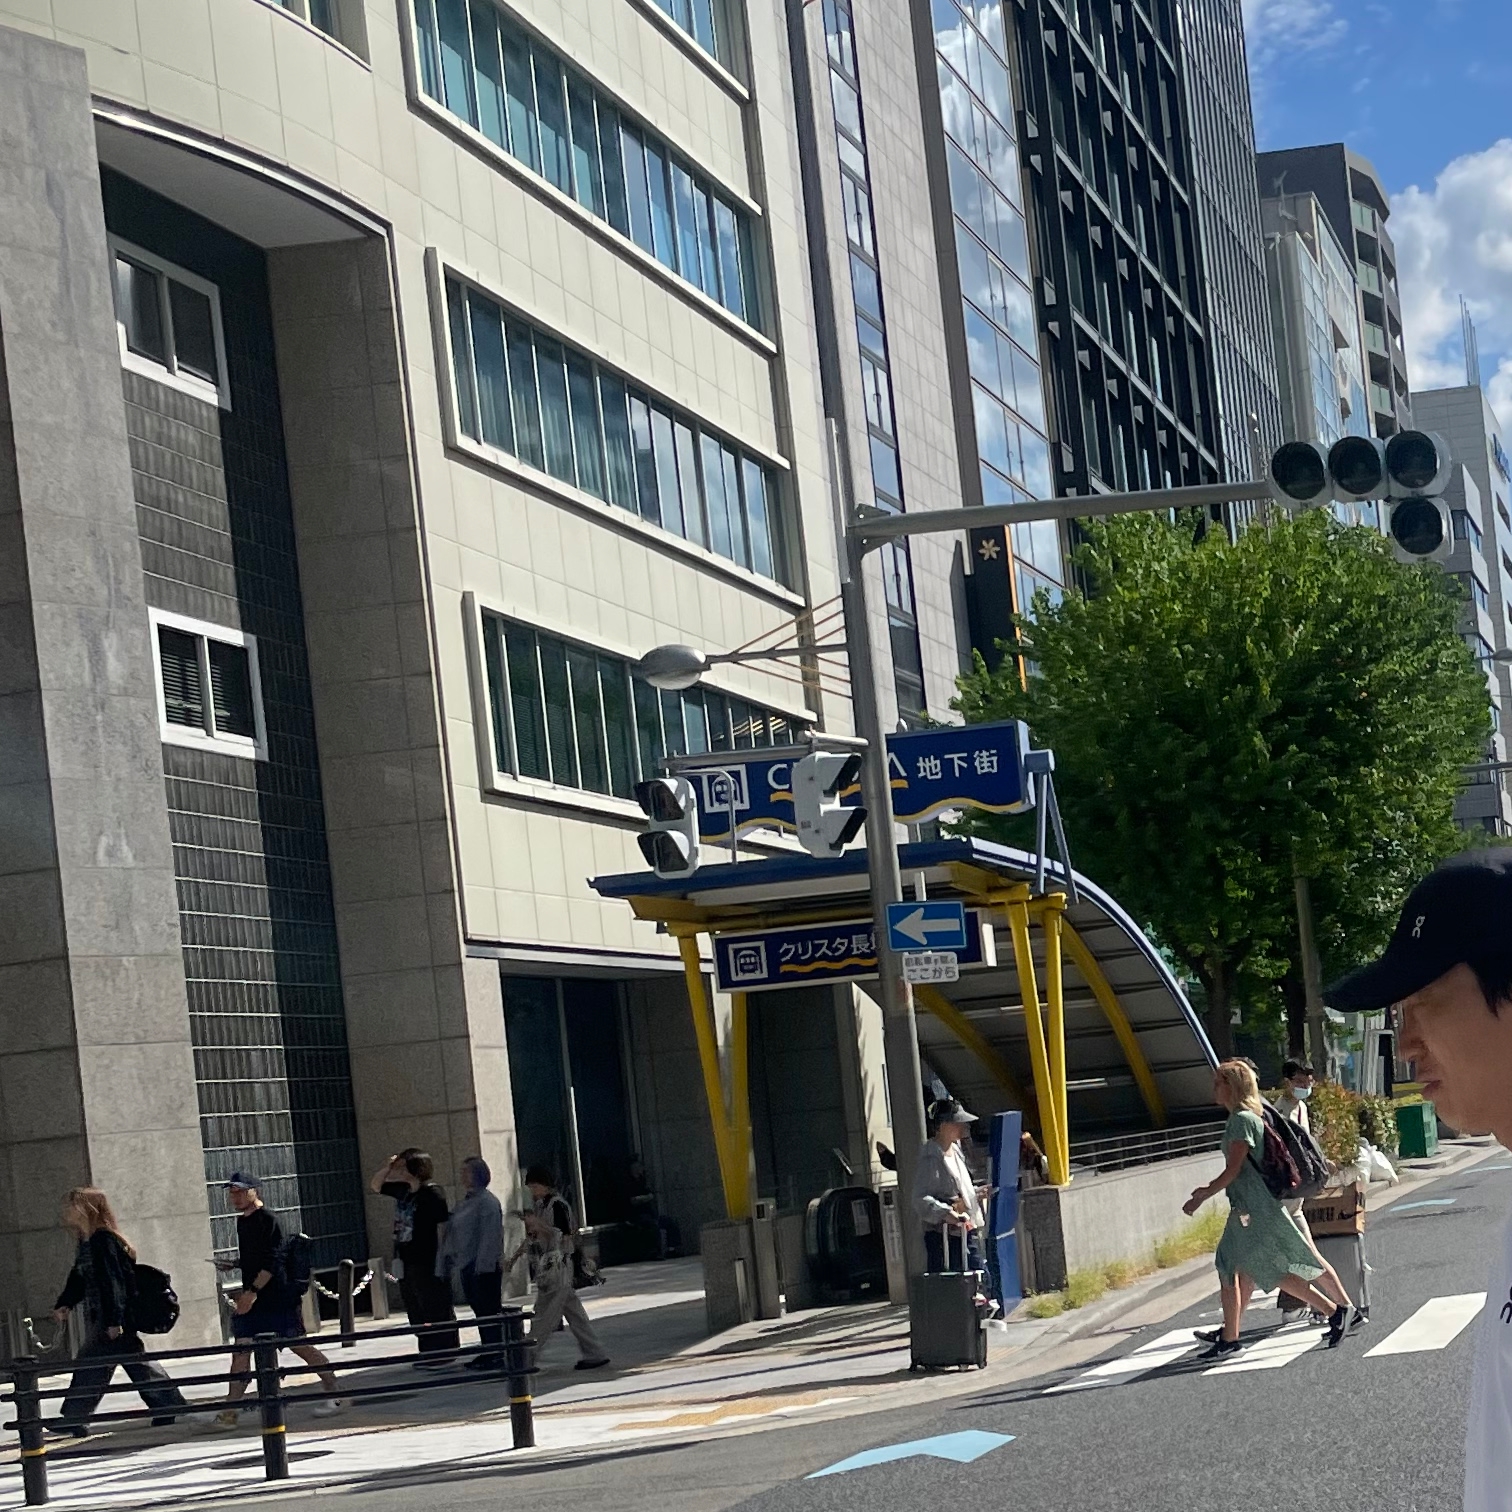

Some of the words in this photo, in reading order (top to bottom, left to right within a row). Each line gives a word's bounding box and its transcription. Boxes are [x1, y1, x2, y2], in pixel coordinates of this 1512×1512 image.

[917, 749, 998, 780] 地下街
[907, 966, 956, 981] ここから
